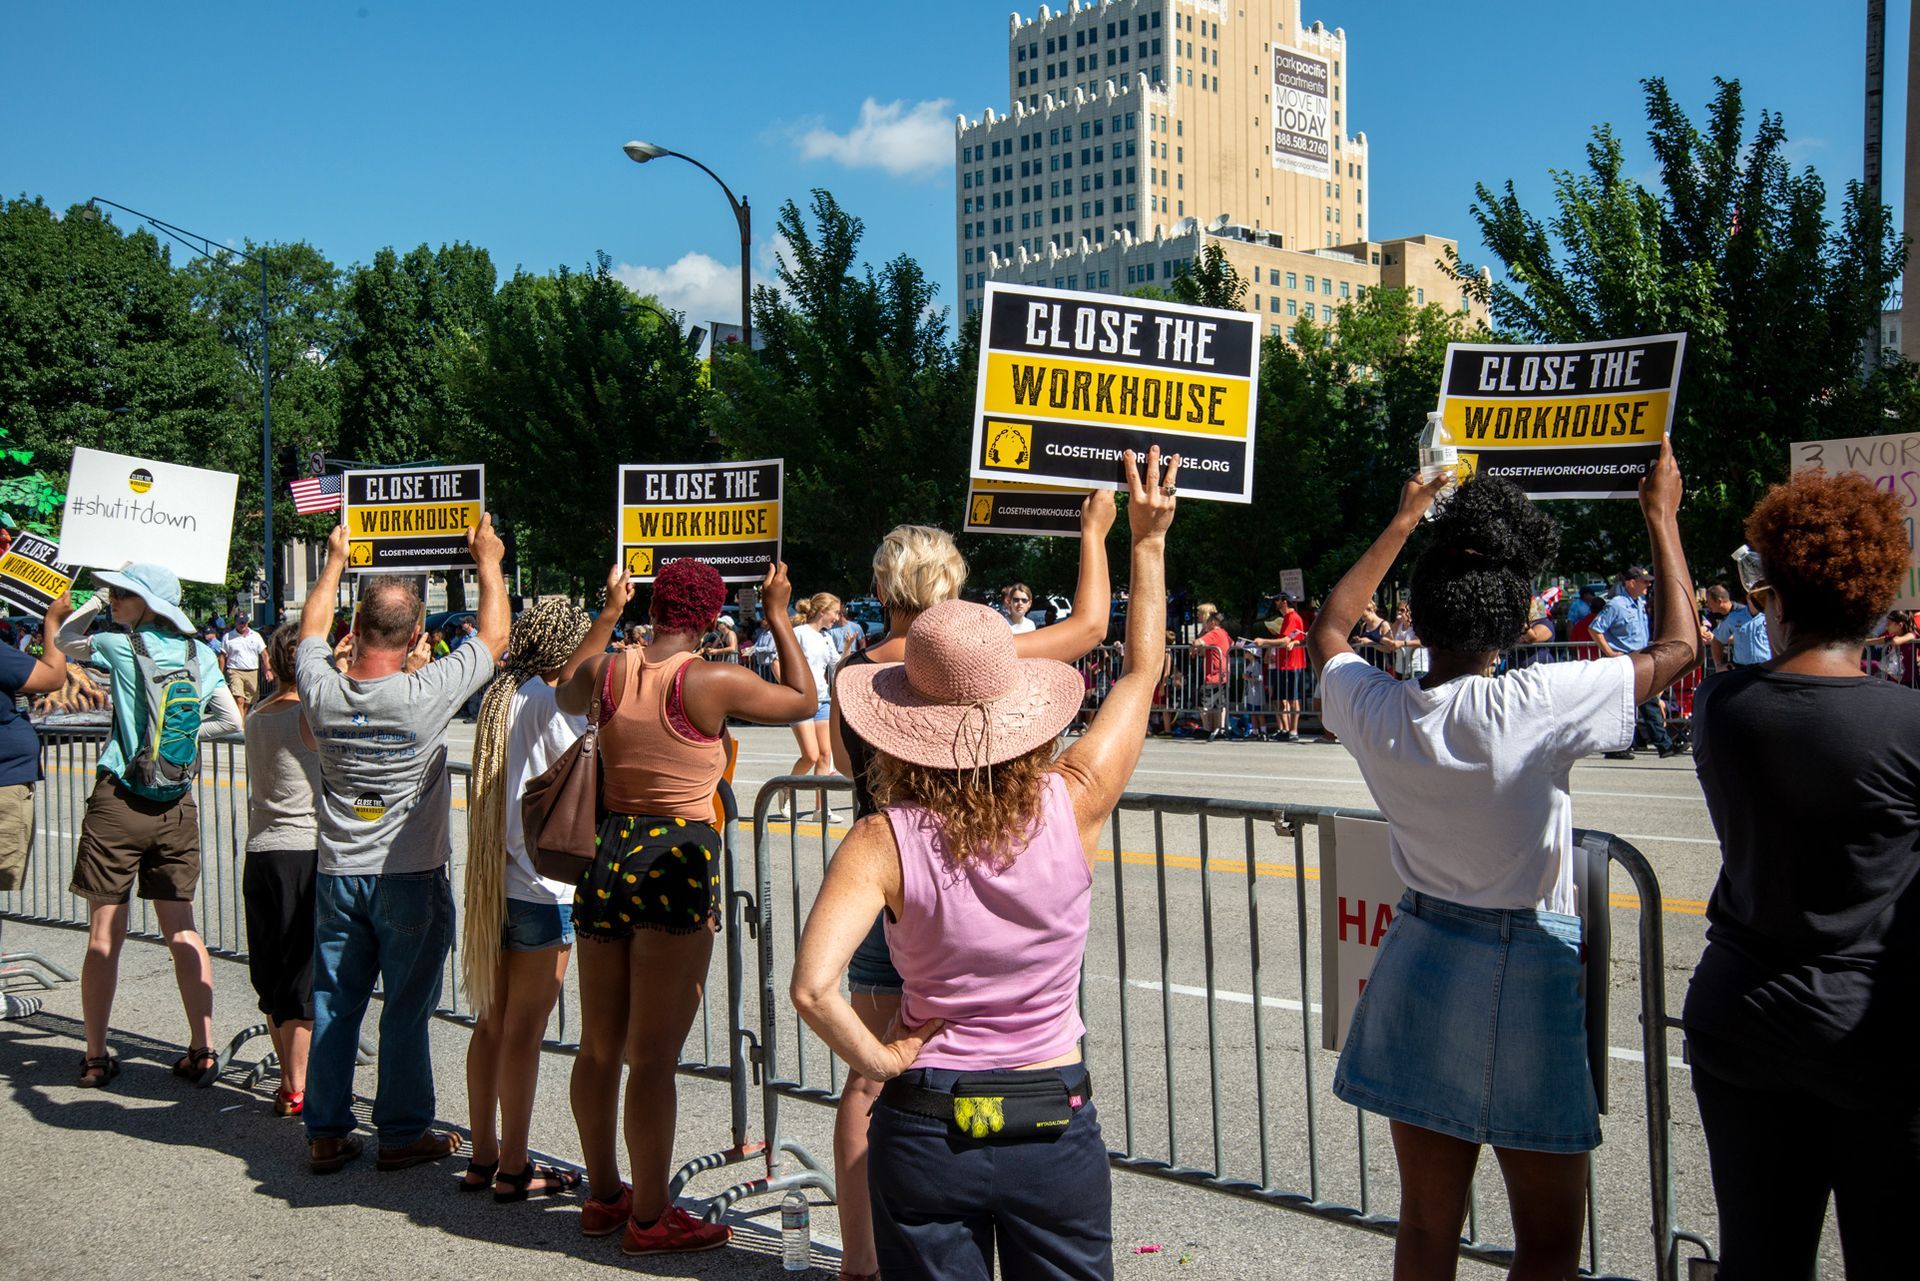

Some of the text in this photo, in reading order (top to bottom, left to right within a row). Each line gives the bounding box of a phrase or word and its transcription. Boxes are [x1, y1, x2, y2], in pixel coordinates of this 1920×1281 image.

[1276, 55, 1326, 79] parkpacific
[1279, 72, 1324, 94] apartments
[1276, 86, 1327, 115] MOVE IN
[1277, 105, 1326, 138] TODAY
[1276, 131, 1327, 156] 888.508.2760
[1025, 301, 1217, 366] CLOSE THE
[1478, 350, 1645, 392] CLOSE THE
[1011, 363, 1228, 426] WORKHOUSE
[1464, 401, 1649, 440] WORKHOUSE
[1845, 436, 1920, 468] WOR
[1488, 463, 1646, 477] CLOSETHEWORKHOUSE.ORG
[366, 473, 462, 501] CLOSE THE
[645, 470, 760, 501] CLOSE THE
[72, 494, 197, 532] #shutitdown
[360, 507, 470, 532] WORKHOUSE
[638, 508, 768, 537] WORKHOUSE
[18, 538, 55, 562] CLOSE
[2, 556, 67, 594] WORKHOUSE
